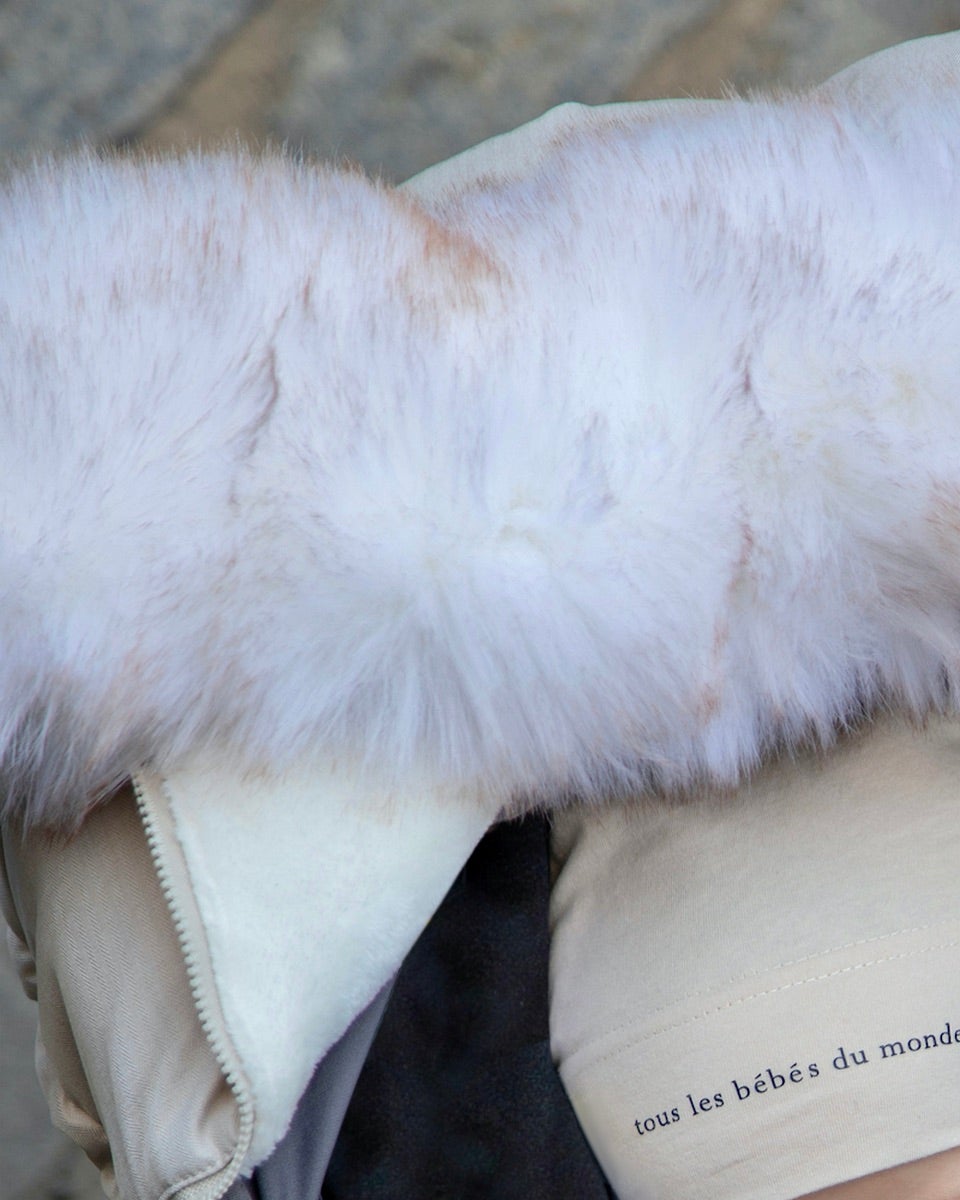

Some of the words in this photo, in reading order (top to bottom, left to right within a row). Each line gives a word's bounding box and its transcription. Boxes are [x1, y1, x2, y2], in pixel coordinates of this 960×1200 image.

[634, 1106, 681, 1135] tous
[687, 1089, 725, 1117] les
[732, 1060, 820, 1101] bébés
[832, 1047, 869, 1071] du
